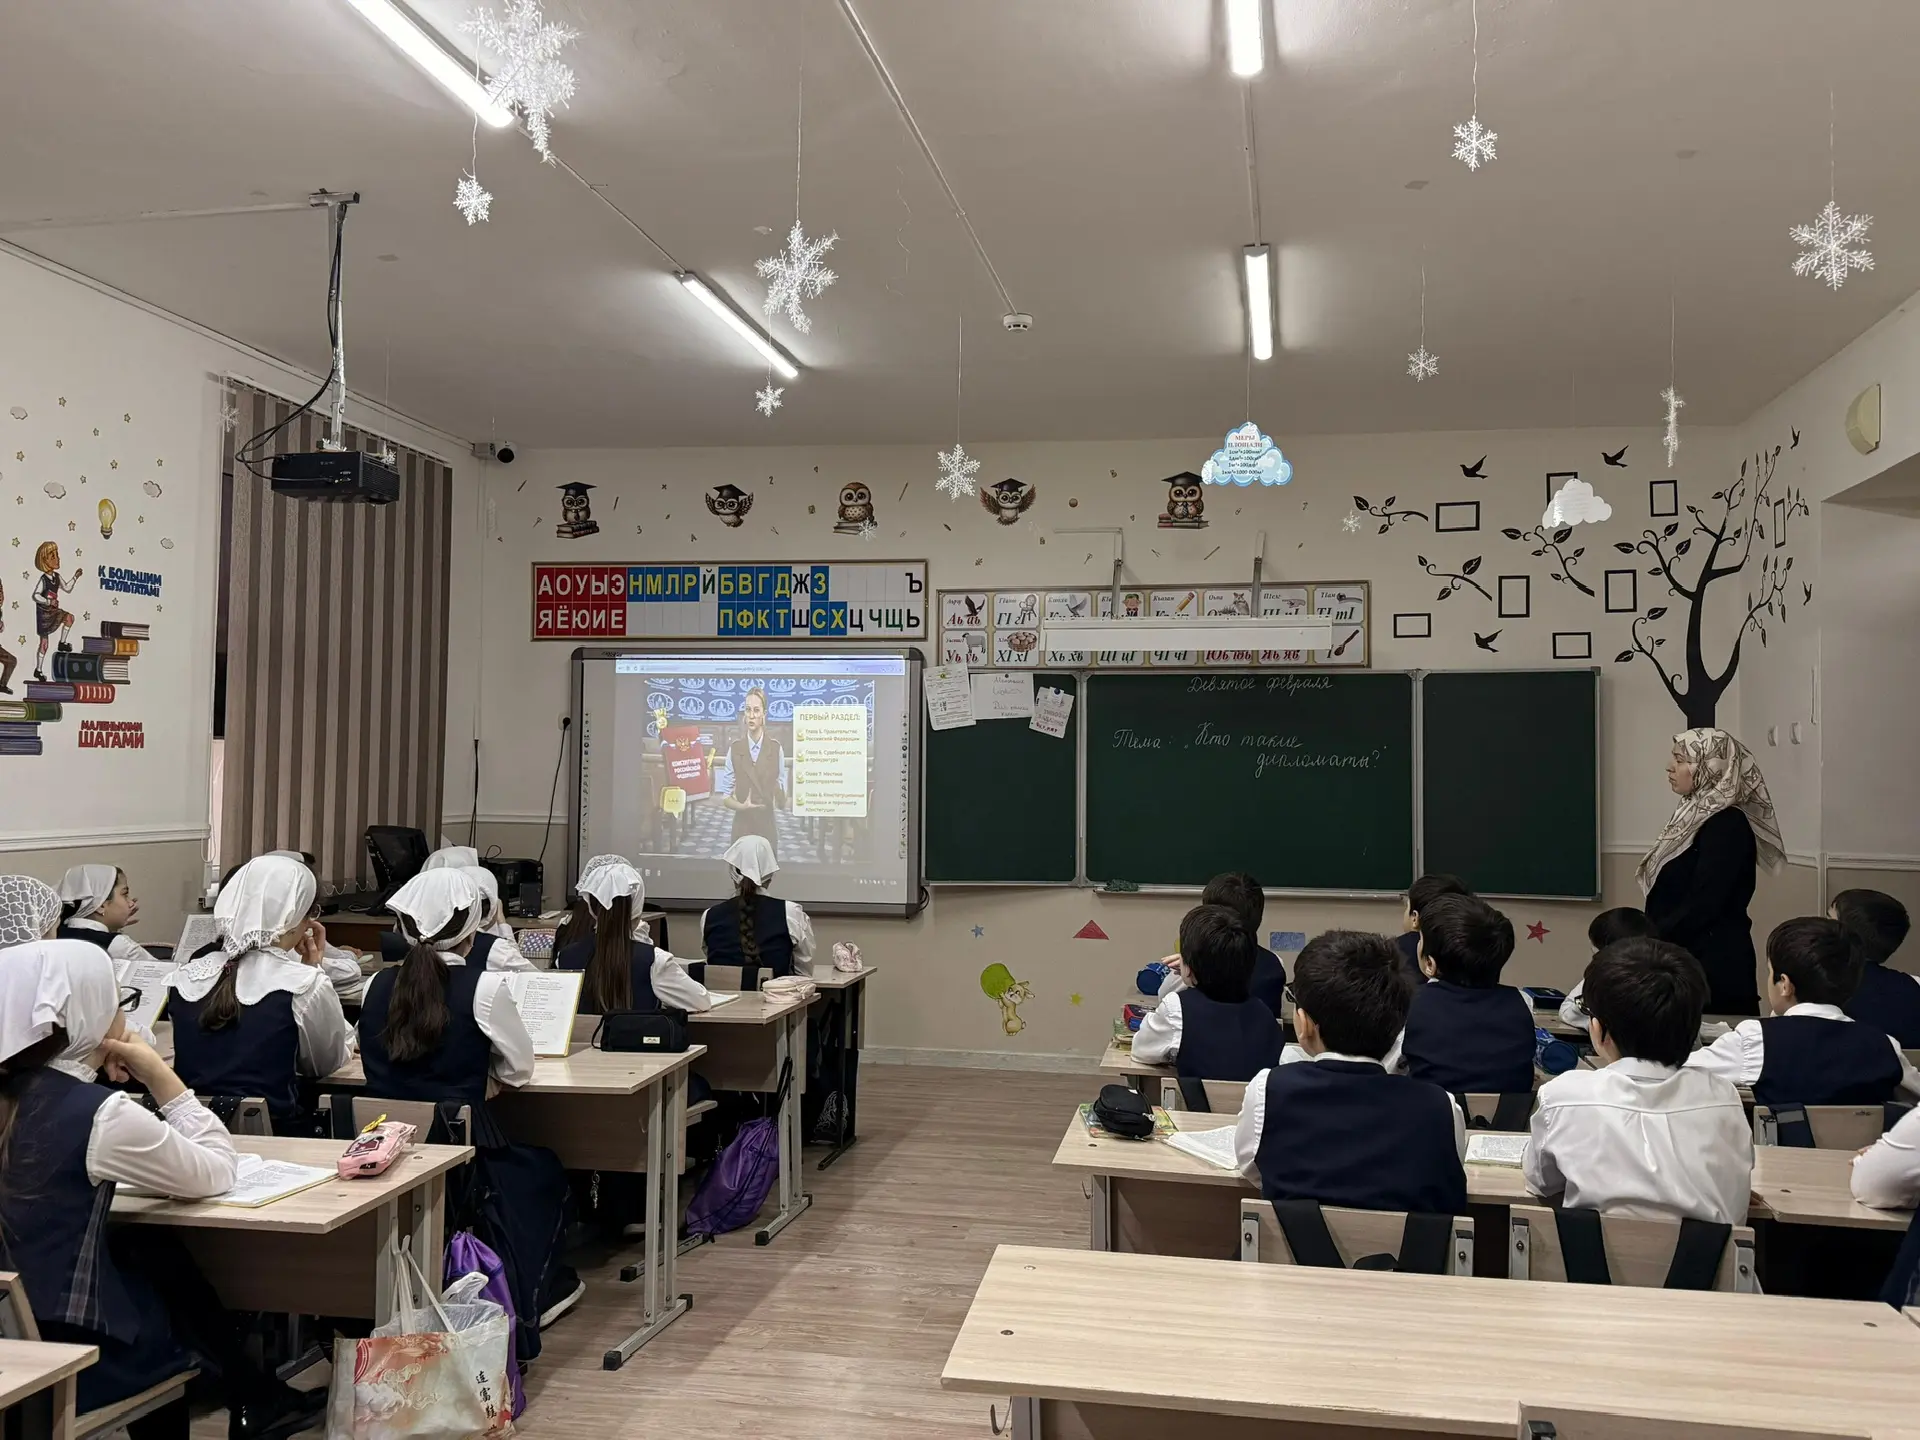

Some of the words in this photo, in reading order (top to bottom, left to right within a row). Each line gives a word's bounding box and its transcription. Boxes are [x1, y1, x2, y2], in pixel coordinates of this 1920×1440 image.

[98, 564, 106, 577] К
[108, 566, 162, 586] БОЛЬШИМ
[946, 612, 963, 625] Аь
[966, 616, 981, 625] аь
[945, 650, 962, 662] Уь
[1187, 675, 1256, 693] Девятое
[1265, 674, 1334, 697] февраля
[800, 712, 830, 721] ПЕРВЫЙ
[831, 713, 861, 721] РАЗДЕЛ:
[81, 720, 143, 732] МАЛЕНЬКИМИ
[78, 731, 145, 748] ШАГАМИ
[1240, 733, 1304, 749] такие
